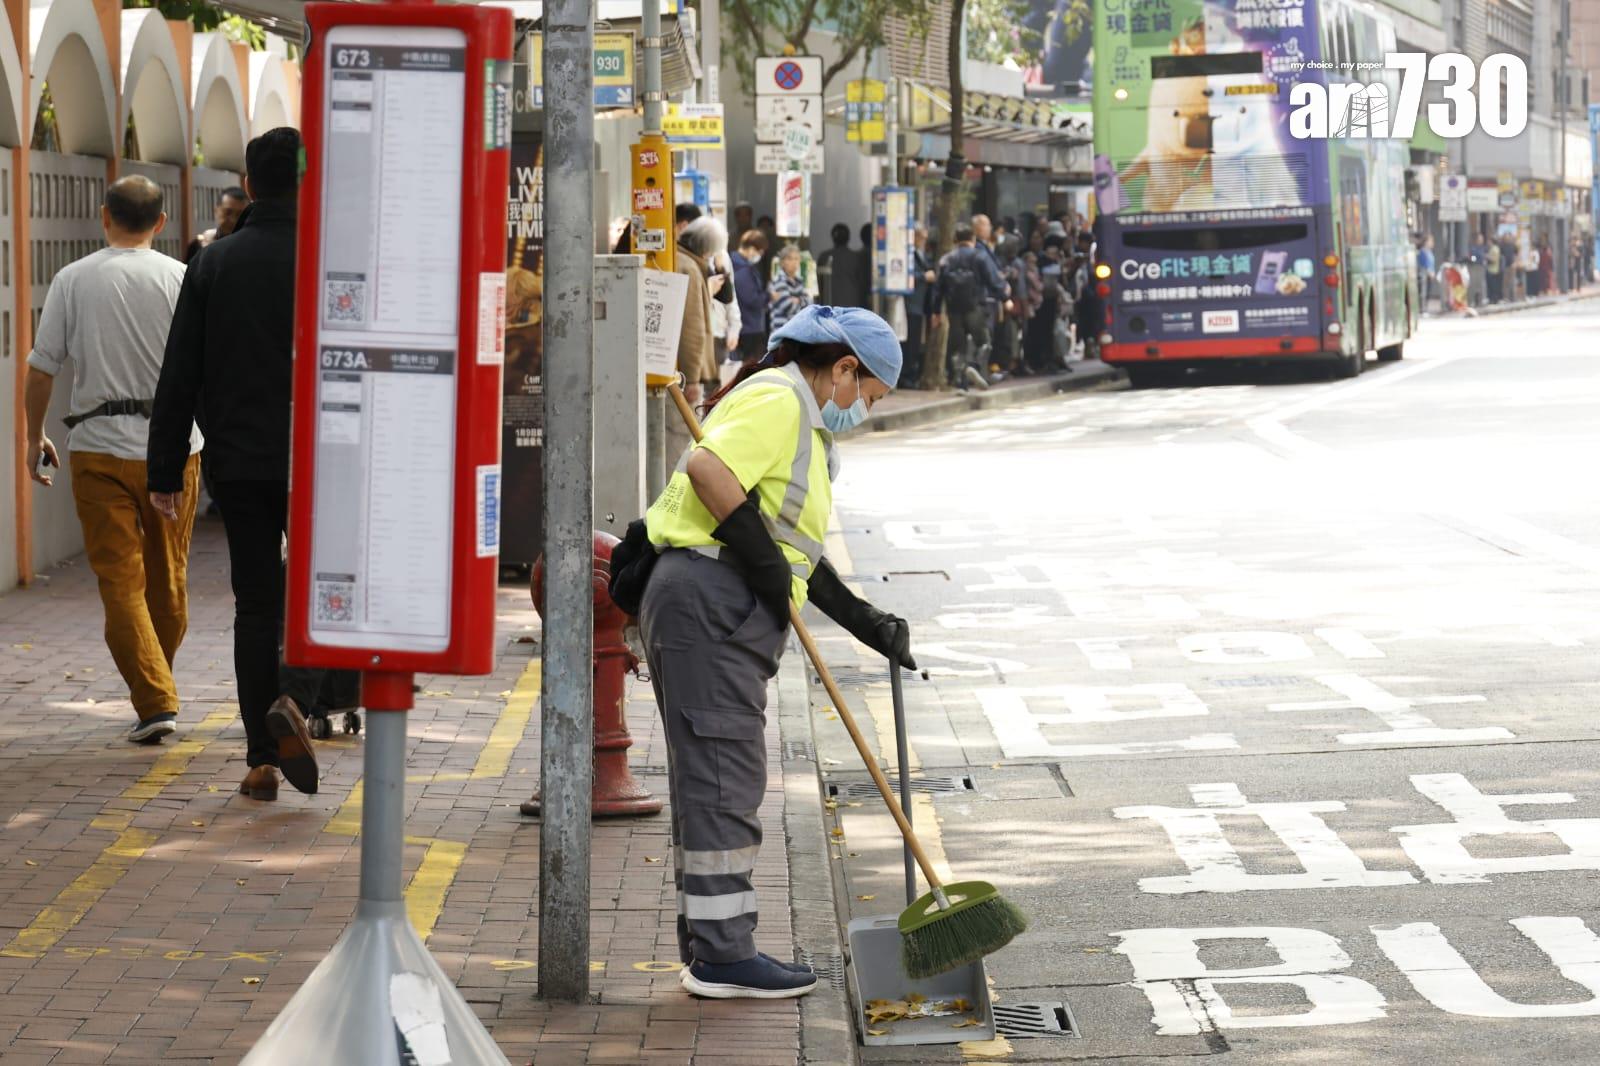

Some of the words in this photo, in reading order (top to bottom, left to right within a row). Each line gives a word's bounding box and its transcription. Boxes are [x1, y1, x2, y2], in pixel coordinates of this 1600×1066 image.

[336, 50, 370, 66] 673
[596, 56, 620, 70] 930
[322, 351, 368, 368] 673A
